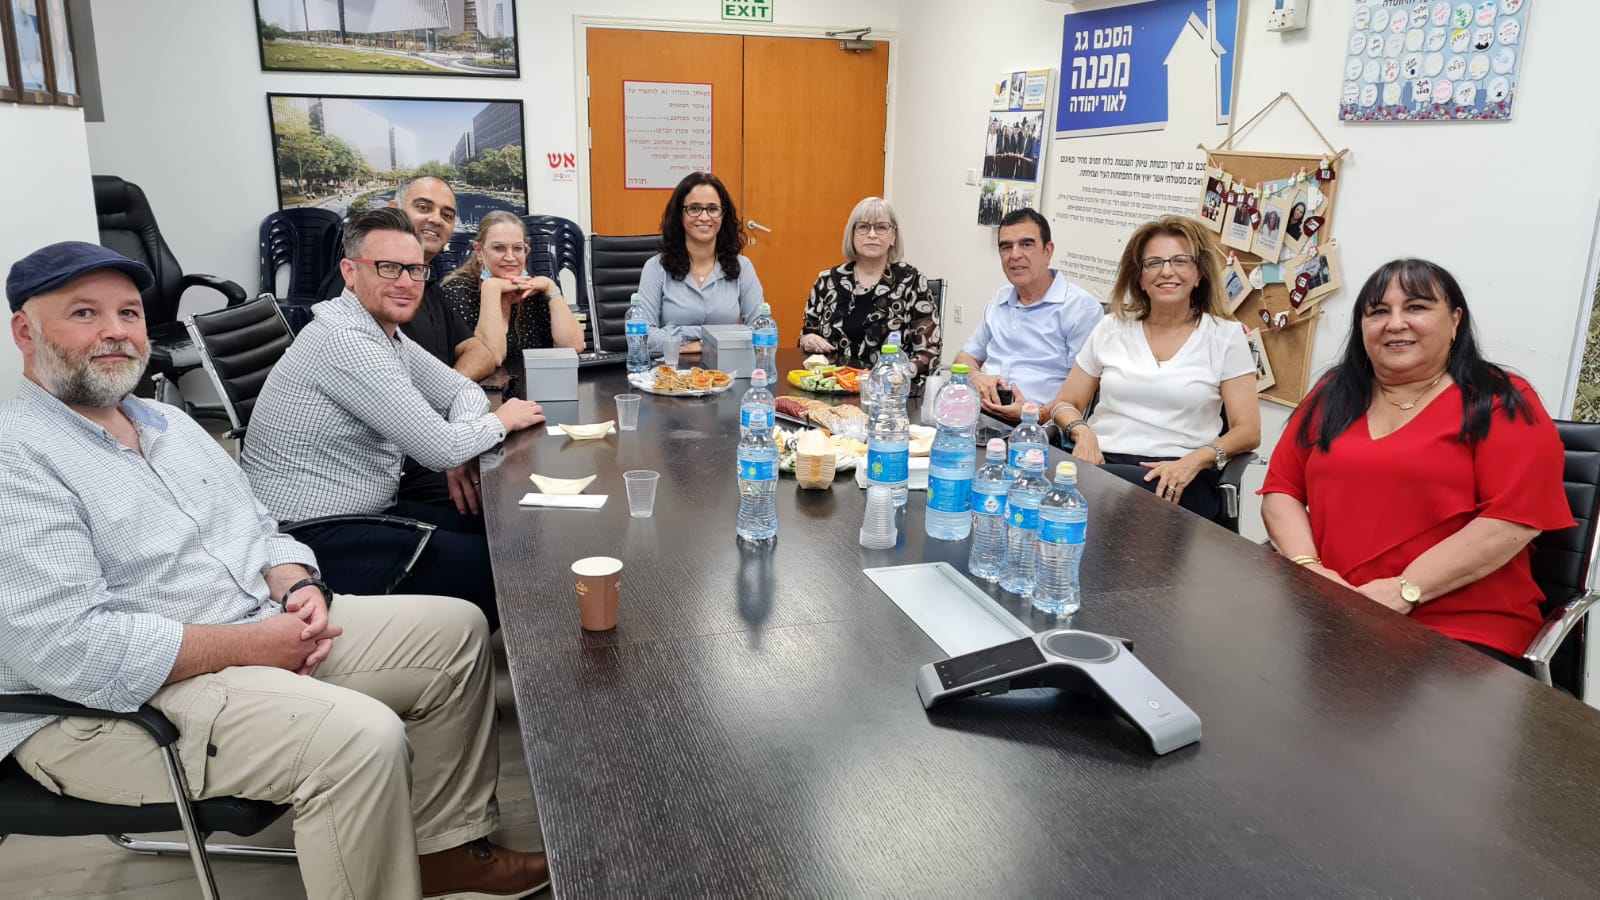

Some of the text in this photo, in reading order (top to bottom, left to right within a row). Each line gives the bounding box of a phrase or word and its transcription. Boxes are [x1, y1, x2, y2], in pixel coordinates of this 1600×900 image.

[725, 4, 769, 18] EXIT
[1074, 25, 1133, 51] הסכם גג
[1071, 53, 1131, 89] מפנה
[1069, 90, 1127, 112] לאור יהודה
[547, 152, 575, 168] אש
[1195, 162, 1206, 171] סכם
